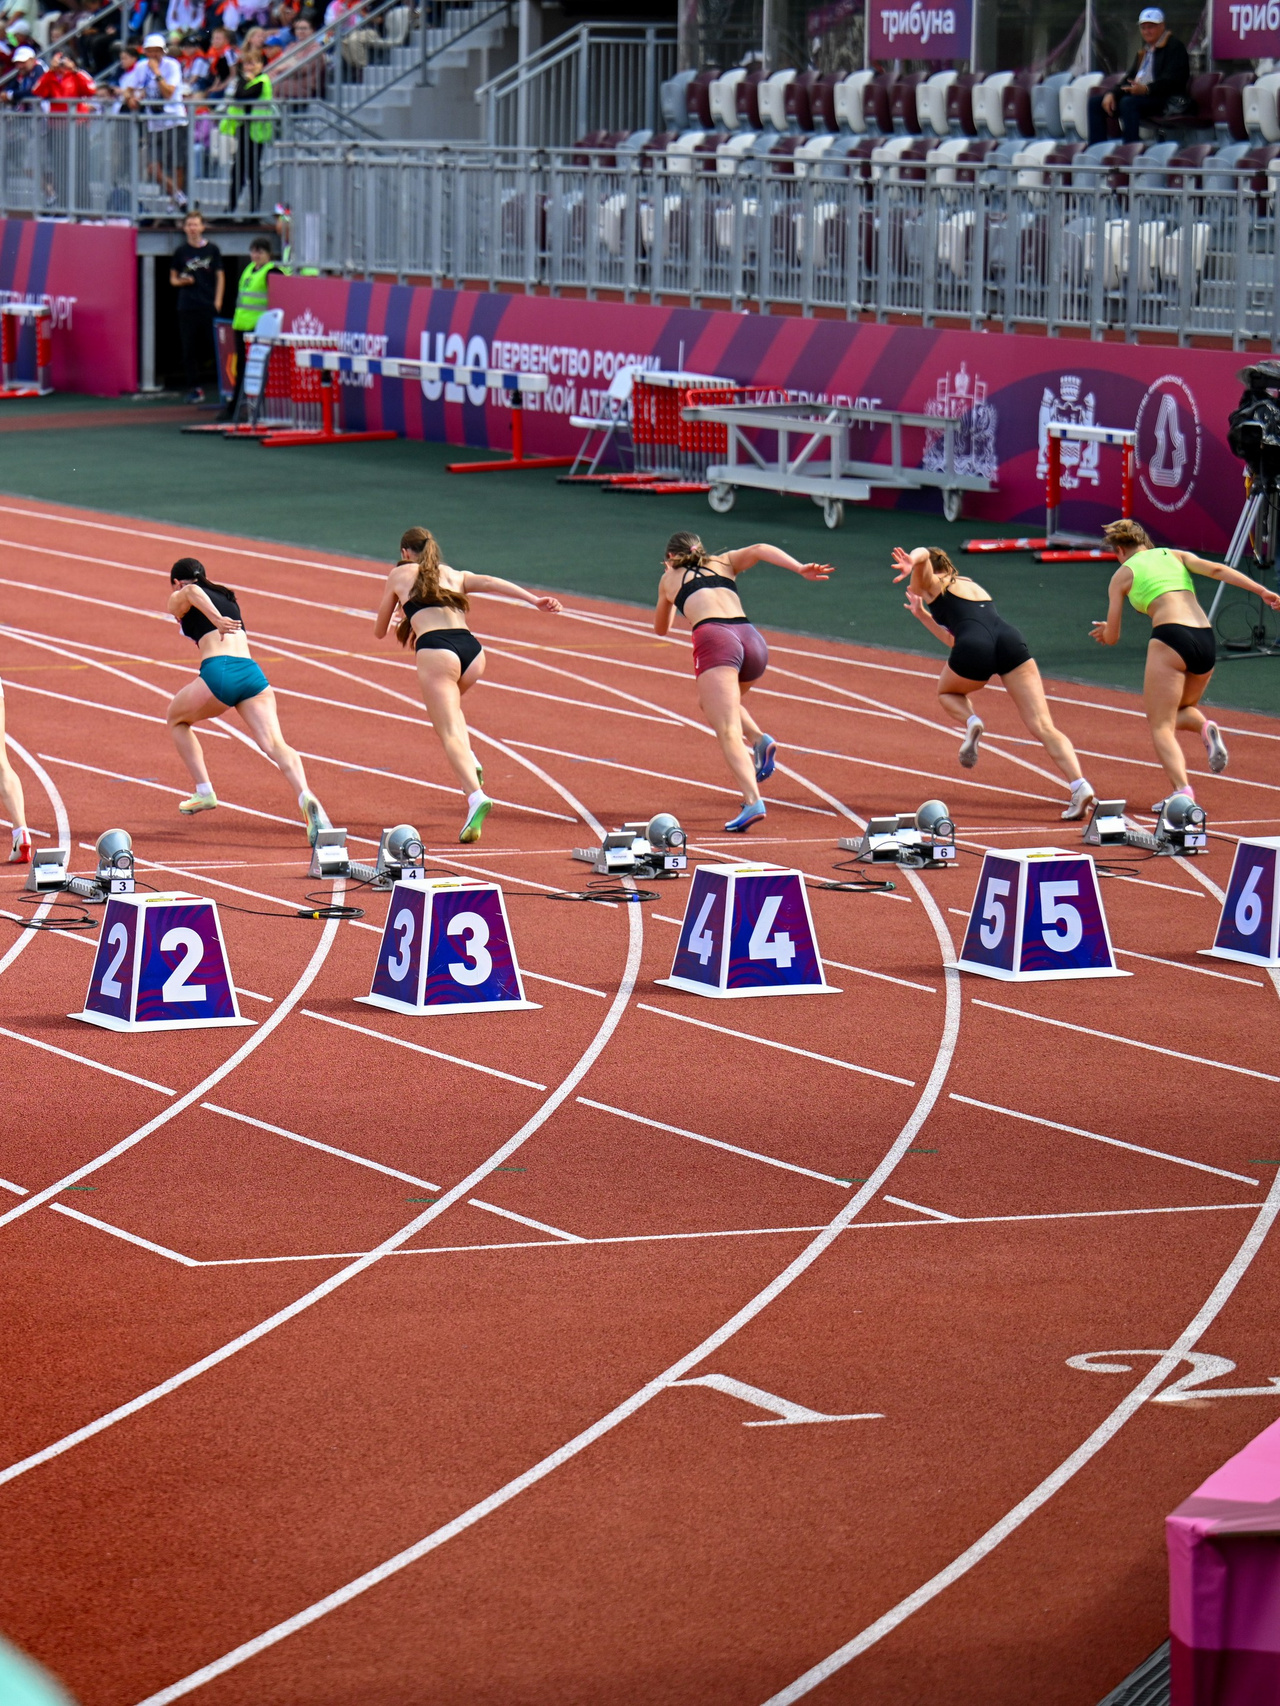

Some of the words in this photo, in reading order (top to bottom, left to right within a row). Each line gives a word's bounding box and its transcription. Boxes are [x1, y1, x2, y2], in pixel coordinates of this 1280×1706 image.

[880, 1, 956, 44] трибуна
[420, 330, 488, 406] U20
[491, 340, 589, 378] ПЕРВЕНСТВО
[521, 378, 577, 415] ГКОЙ
[409, 870, 417, 879] 4
[671, 858, 679, 868] 5
[940, 848, 948, 857] 6
[1192, 836, 1199, 845] 7
[119, 882, 127, 891] 3
[979, 876, 1011, 950] 5
[1038, 880, 1083, 952] 5
[1235, 865, 1262, 935] 6
[100, 922, 129, 999] 2
[158, 926, 208, 1003] 2
[387, 908, 416, 983] 3
[446, 911, 493, 987] 3
[687, 892, 715, 966] 4
[747, 895, 796, 968] 4
